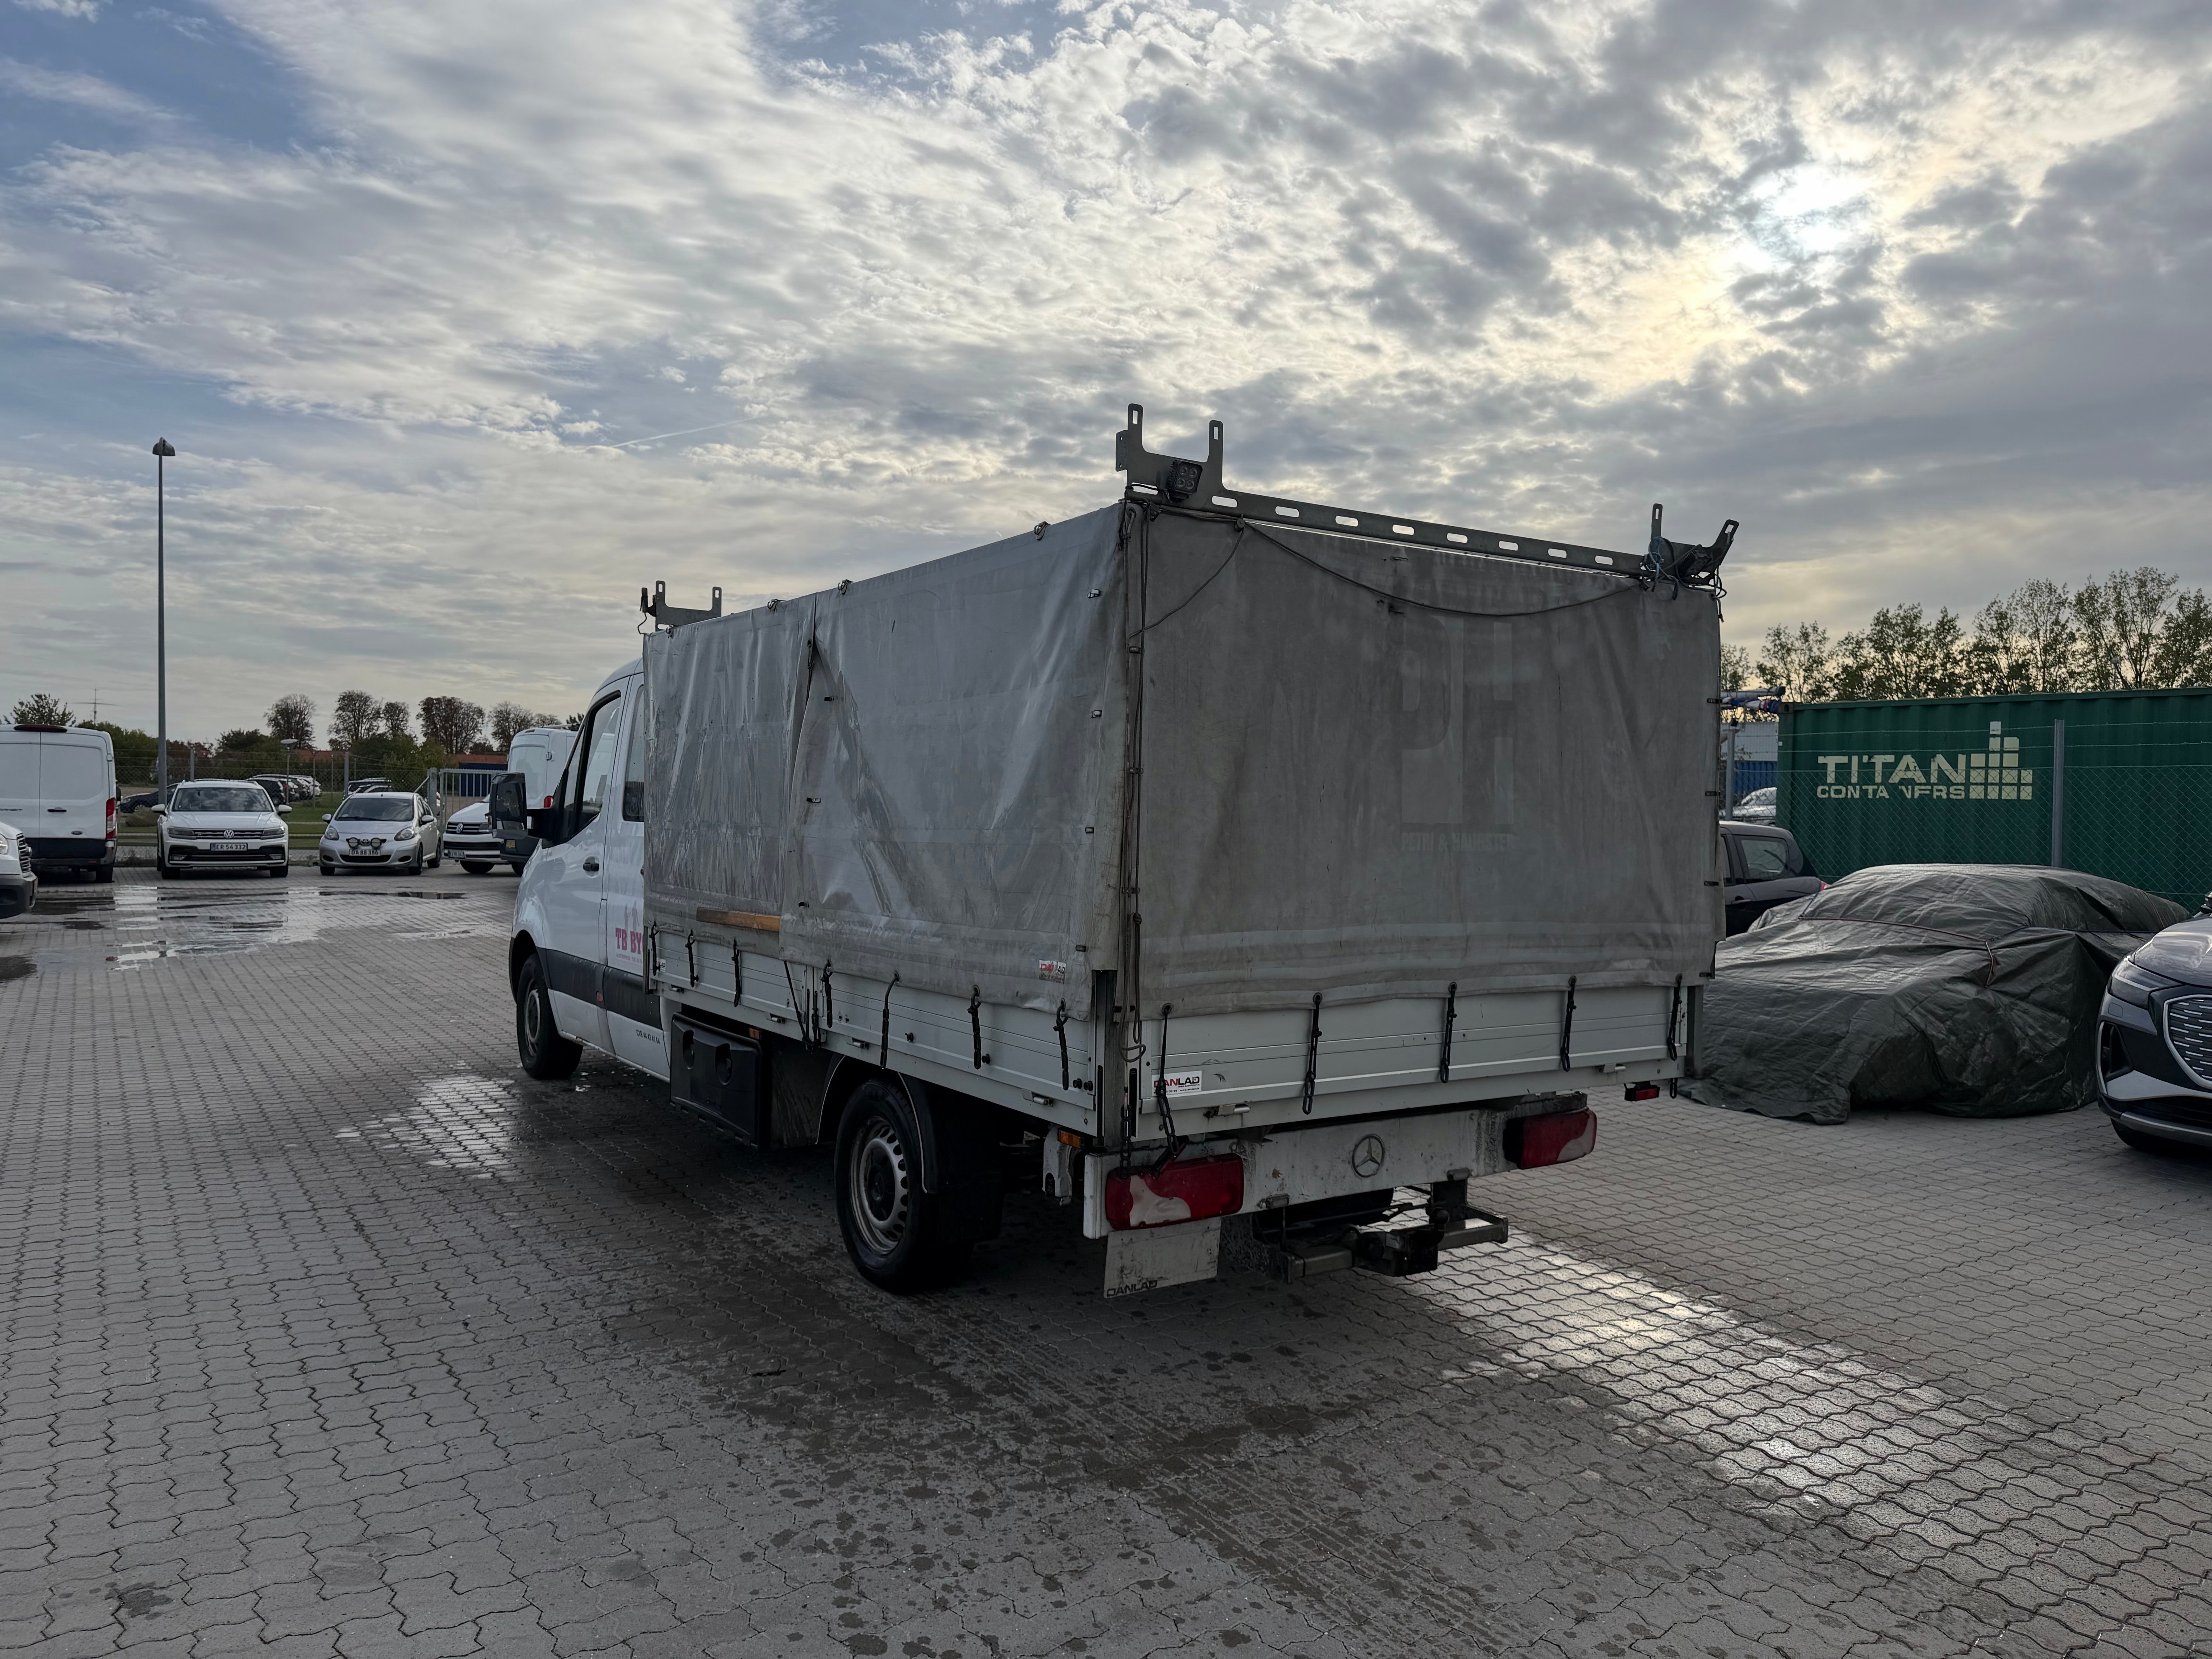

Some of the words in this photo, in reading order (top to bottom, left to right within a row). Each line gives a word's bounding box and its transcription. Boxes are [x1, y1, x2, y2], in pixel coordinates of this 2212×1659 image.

[1817, 754, 1966, 783] TITAN
[615, 927, 627, 951] TB
[630, 931, 643, 955] BY
[1107, 1279, 1158, 1297] DANLAD
